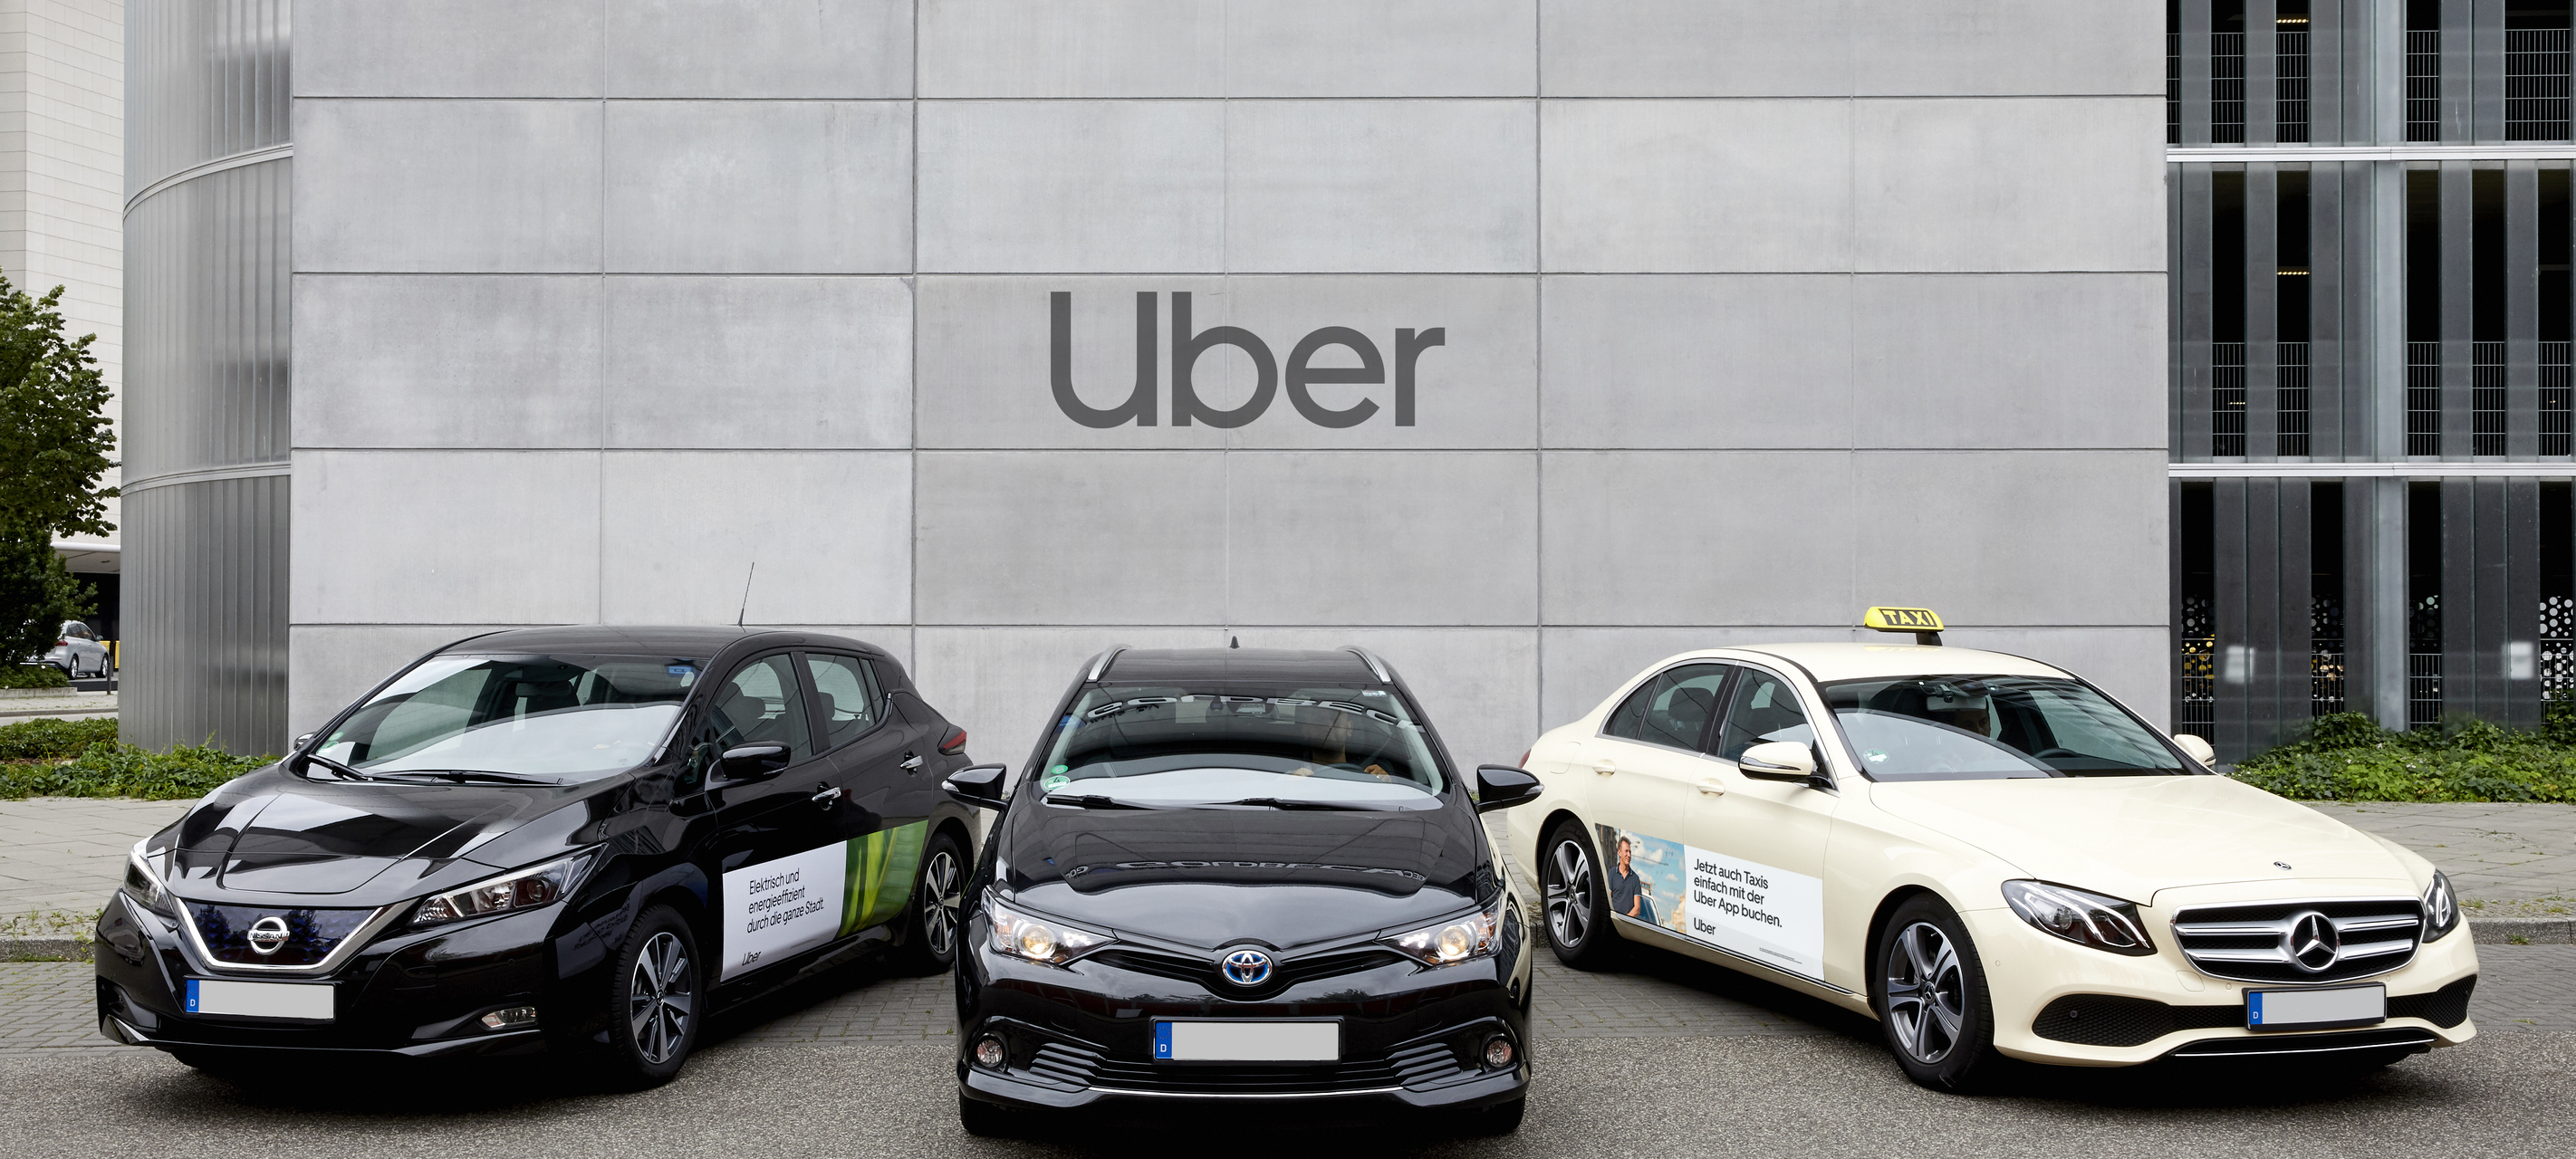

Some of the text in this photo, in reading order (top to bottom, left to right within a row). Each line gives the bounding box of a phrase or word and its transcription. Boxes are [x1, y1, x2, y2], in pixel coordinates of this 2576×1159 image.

[1050, 291, 1446, 429] Uber
[1882, 610, 1935, 626] TAXI
[749, 867, 800, 895] Elektrisch und
[1694, 858, 1769, 889] Jetzt auch Taxis
[748, 885, 805, 915] energieeffizient
[1694, 875, 1764, 905] einfach mit der
[746, 915, 769, 934] durch
[770, 911, 782, 926] die
[783, 905, 804, 925] ganze
[1694, 889, 1783, 928] Uber App buchen.
[249, 932, 283, 941] NISSAN
[1693, 916, 1716, 935] Uber
[741, 951, 762, 966] Uber
[189, 999, 196, 1007] D
[2253, 1011, 2259, 1020] D
[1160, 1044, 1167, 1052] D
